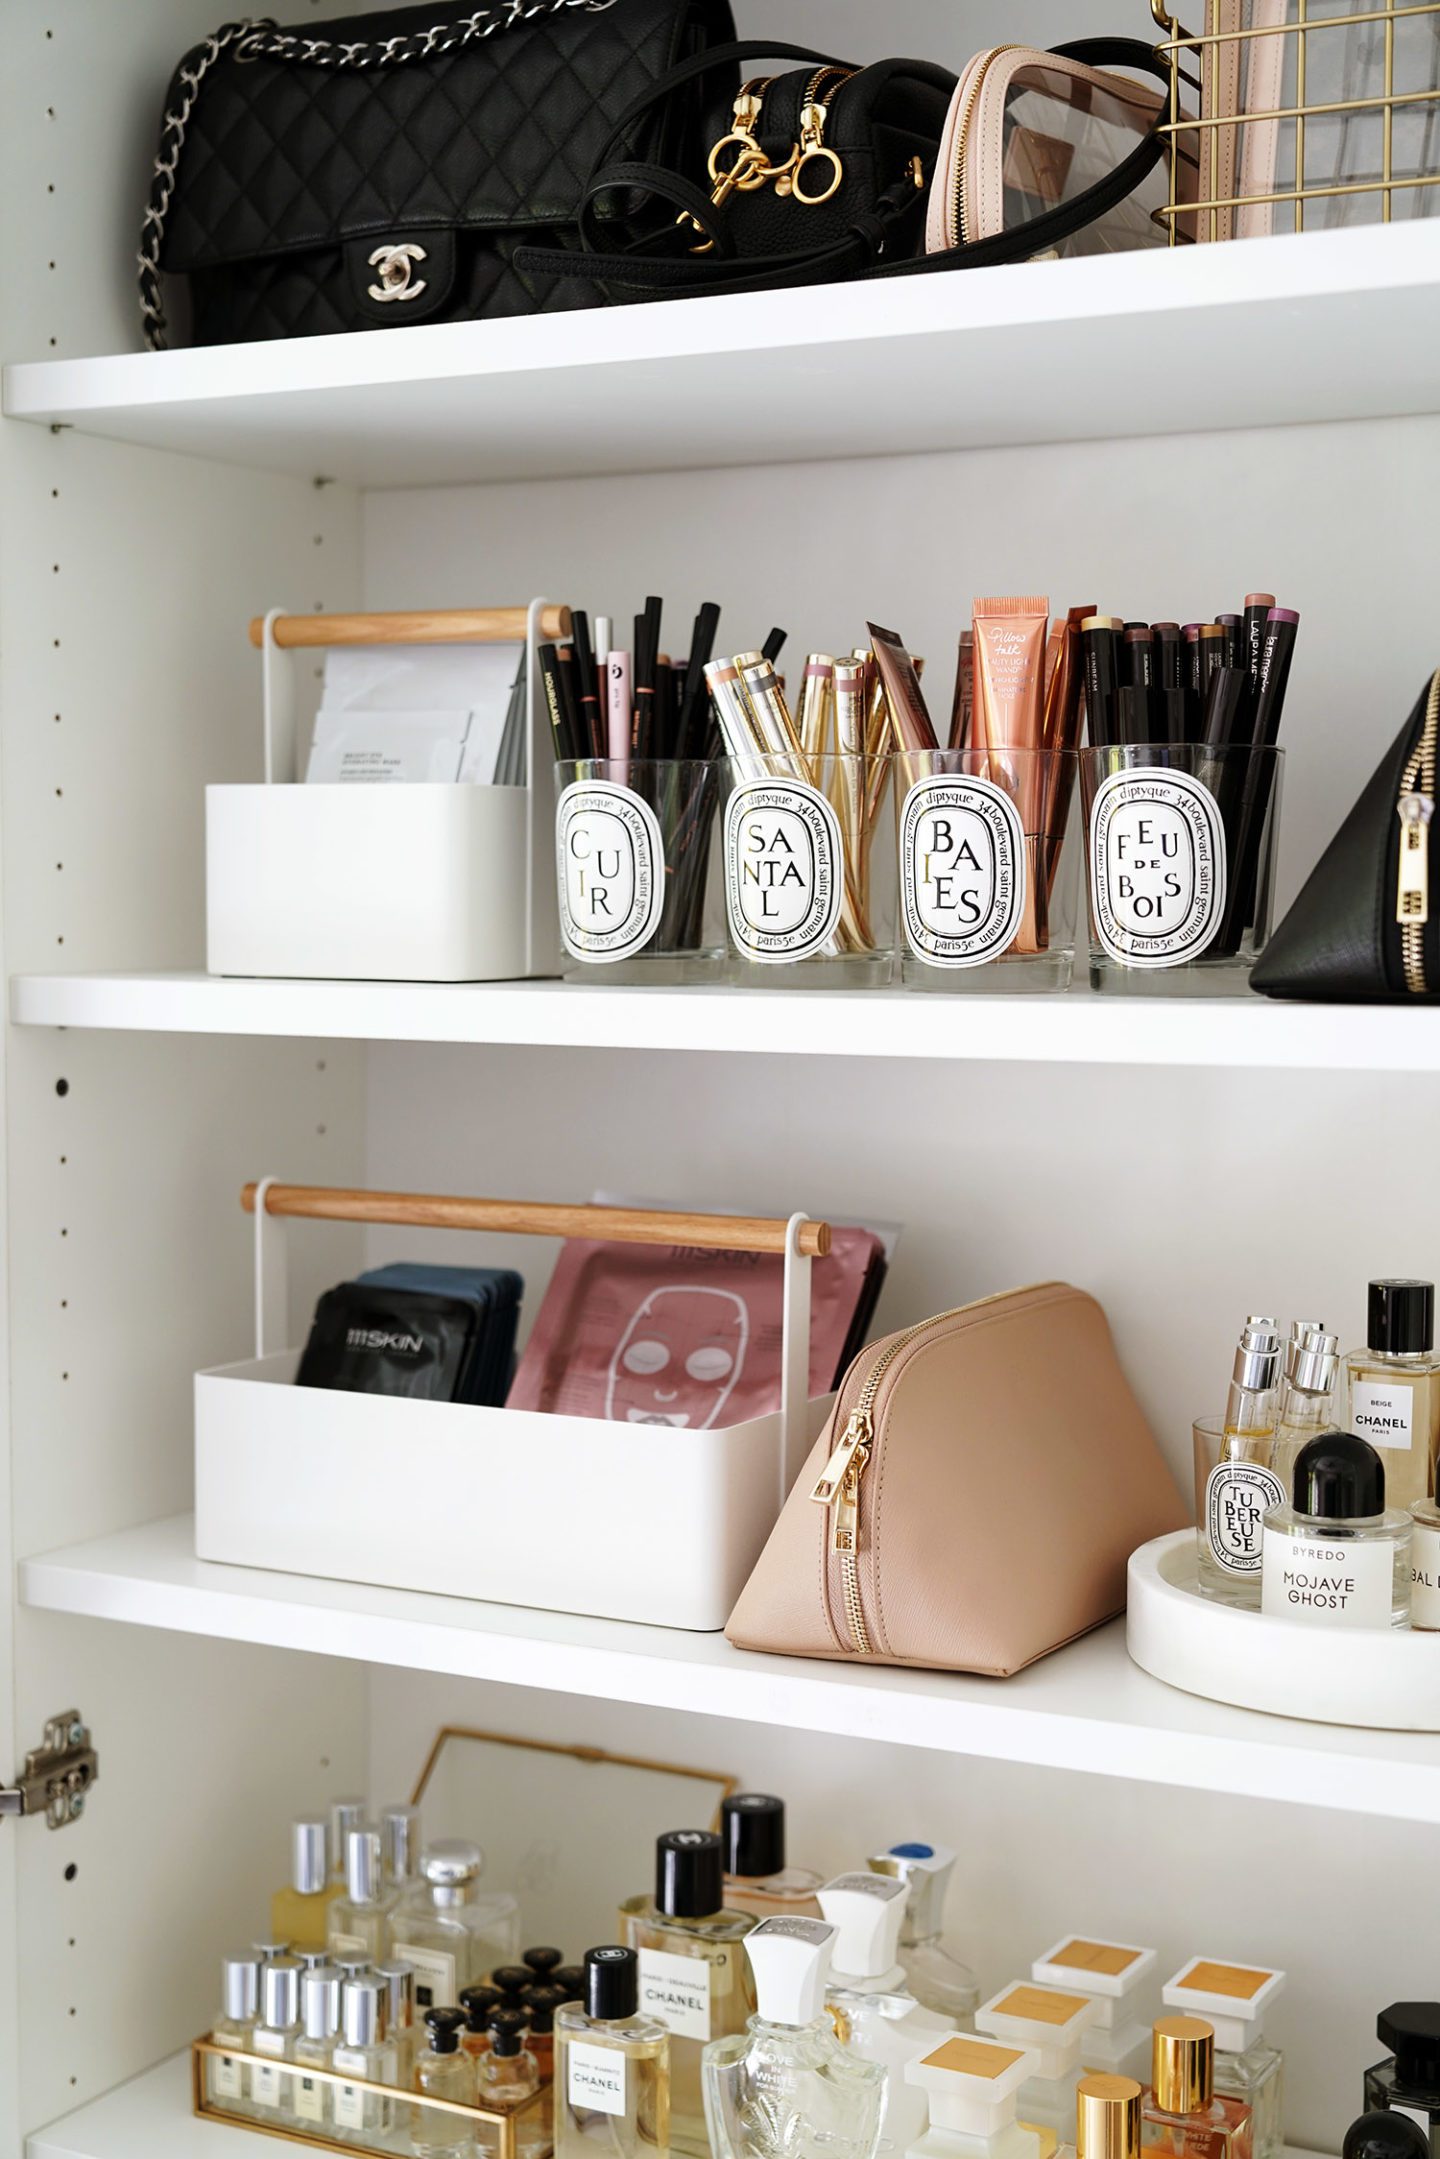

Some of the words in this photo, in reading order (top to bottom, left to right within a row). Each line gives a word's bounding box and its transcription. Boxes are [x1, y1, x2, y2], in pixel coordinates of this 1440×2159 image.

[987, 627, 1026, 644] Pillow
[995, 643, 1022, 655] talk
[544, 672, 561, 726] HOURGLASS
[573, 798, 615, 810] diptyque
[748, 793, 793, 809] diptyque
[926, 791, 974, 806] diptyque
[1119, 786, 1171, 801] diptyque
[1173, 794, 1190, 809] 34
[617, 806, 629, 819] 34
[795, 802, 810, 815] 34
[976, 800, 991, 816] 34
[1099, 796, 1118, 841] germain
[906, 800, 924, 845] germain
[1186, 802, 1211, 862] boulevard
[628, 812, 649, 868] boulevard
[807, 808, 829, 866] boulevard
[988, 807, 1012, 868] boulevard
[905, 847, 913, 872] saint
[1097, 843, 1105, 872] saint
[1134, 859, 1160, 869] DE
[639, 870, 650, 898] saint
[819, 867, 830, 897] saint
[1000, 869, 1011, 899] saint
[1199, 863, 1211, 895] saint
[906, 876, 921, 935] boulevard
[1097, 875, 1114, 935] boulevard
[620, 898, 647, 940] germain
[799, 896, 827, 940] germain
[979, 899, 1008, 943] germain
[1179, 895, 1209, 943] germain
[1370, 1399, 1393, 1408] BEIGE
[1355, 1414, 1408, 1429] CHANEL
[1227, 1471, 1258, 1481] dptyque
[1266, 1484, 1279, 1505] boule
[1292, 1546, 1346, 1562] BYREDO
[1283, 1571, 1356, 1593] MOJAVE
[1411, 1568, 1433, 1587] BAL
[1288, 1589, 1348, 1610] GHOST
[645, 1988, 705, 2011] CHANEL
[764, 2052, 794, 2067] OVE
[574, 2072, 621, 2092] CHANEL
